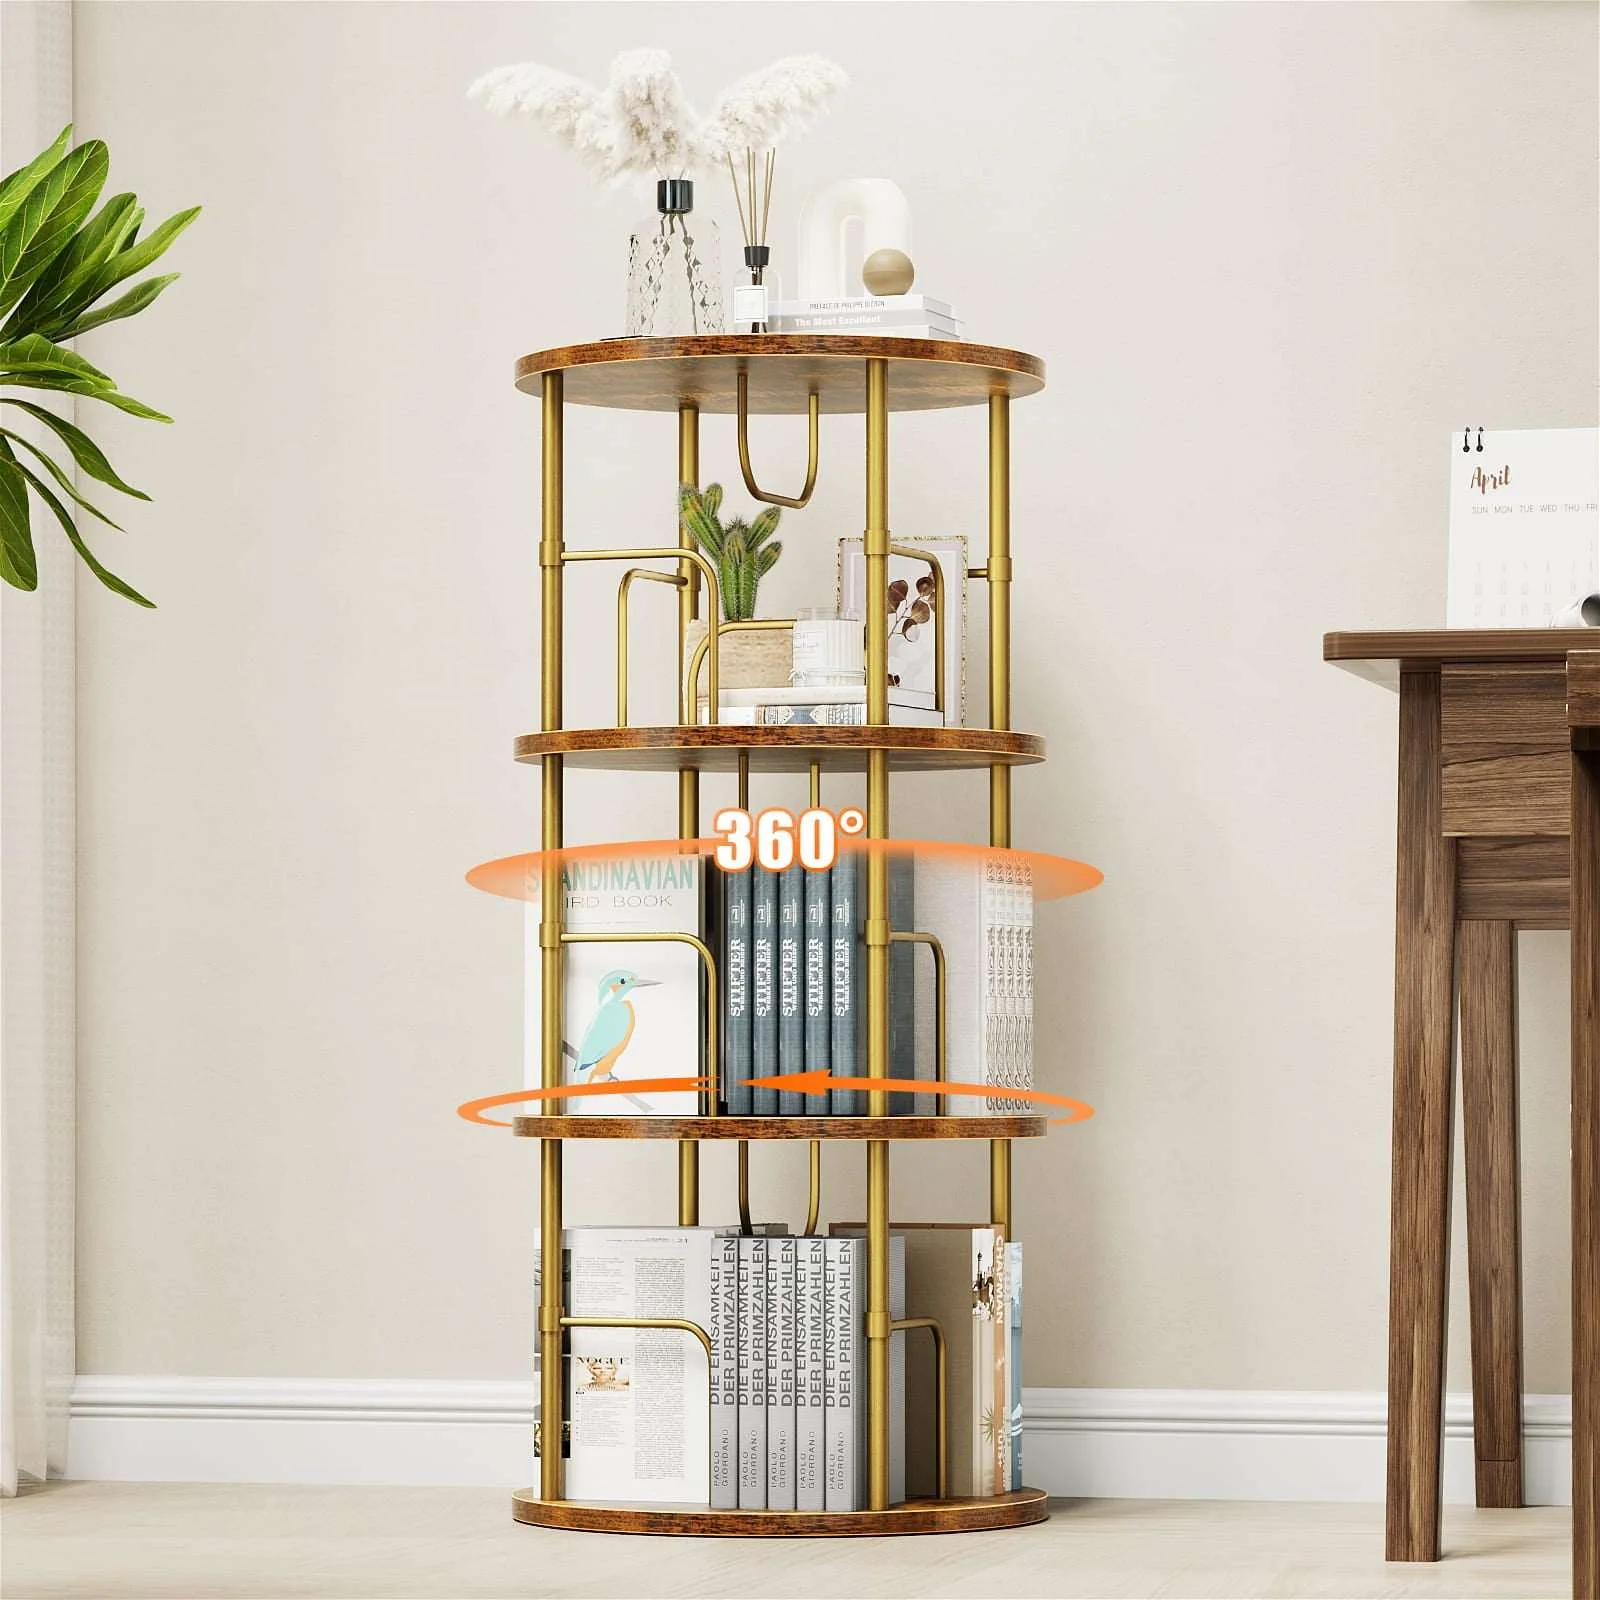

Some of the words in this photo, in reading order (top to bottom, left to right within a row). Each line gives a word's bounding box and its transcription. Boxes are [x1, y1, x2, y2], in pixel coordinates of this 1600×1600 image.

[794, 317, 812, 328] The
[1470, 464, 1510, 494] April
[1494, 505, 1513, 514] MON
[1519, 504, 1534, 513] TUE
[1540, 504, 1558, 513] WED
[1564, 503, 1580, 512] THU
[1586, 503, 1598, 512] FRI
[613, 895, 673, 909] BOOK
[730, 938, 741, 1017] STIFTER
[756, 938, 767, 1017] STIFTER
[782, 938, 793, 1017] STIFTER
[808, 938, 819, 1017] STIFTER
[834, 938, 845, 1017] STIFTER
[723, 1239, 735, 1361] PRIMZAHLEN
[752, 1239, 764, 1361] PRIMZAHLEN
[781, 1240, 793, 1362] PRIMZAHLEN
[810, 1240, 822, 1362] PRIMZAHLEN
[839, 1241, 851, 1363] PRIMZAHLEN
[995, 1235, 1005, 1325] CHAPMAN
[710, 1256, 720, 1369] EINSAMKEIT
[739, 1256, 749, 1369] EINSAMKEIT
[767, 1256, 777, 1370] EINSAMKEIT
[796, 1256, 806, 1370] EINSAMKEIT
[825, 1257, 835, 1371] EINSAMKEIT
[710, 1375, 720, 1405] DIE
[723, 1367, 735, 1406] DER
[739, 1376, 749, 1406] DIE
[752, 1368, 764, 1406] DER
[767, 1376, 777, 1406] DIE
[781, 1368, 793, 1407] DER
[796, 1376, 806, 1407] DIE
[810, 1369, 822, 1407] DER
[825, 1376, 835, 1407] DIE
[839, 1370, 851, 1408] DER
[721, 1429, 729, 1487] GIORDANO
[750, 1430, 758, 1488] GIORDANO
[779, 1430, 787, 1488] GIORDANO
[837, 1432, 845, 1490] GIORDANO
